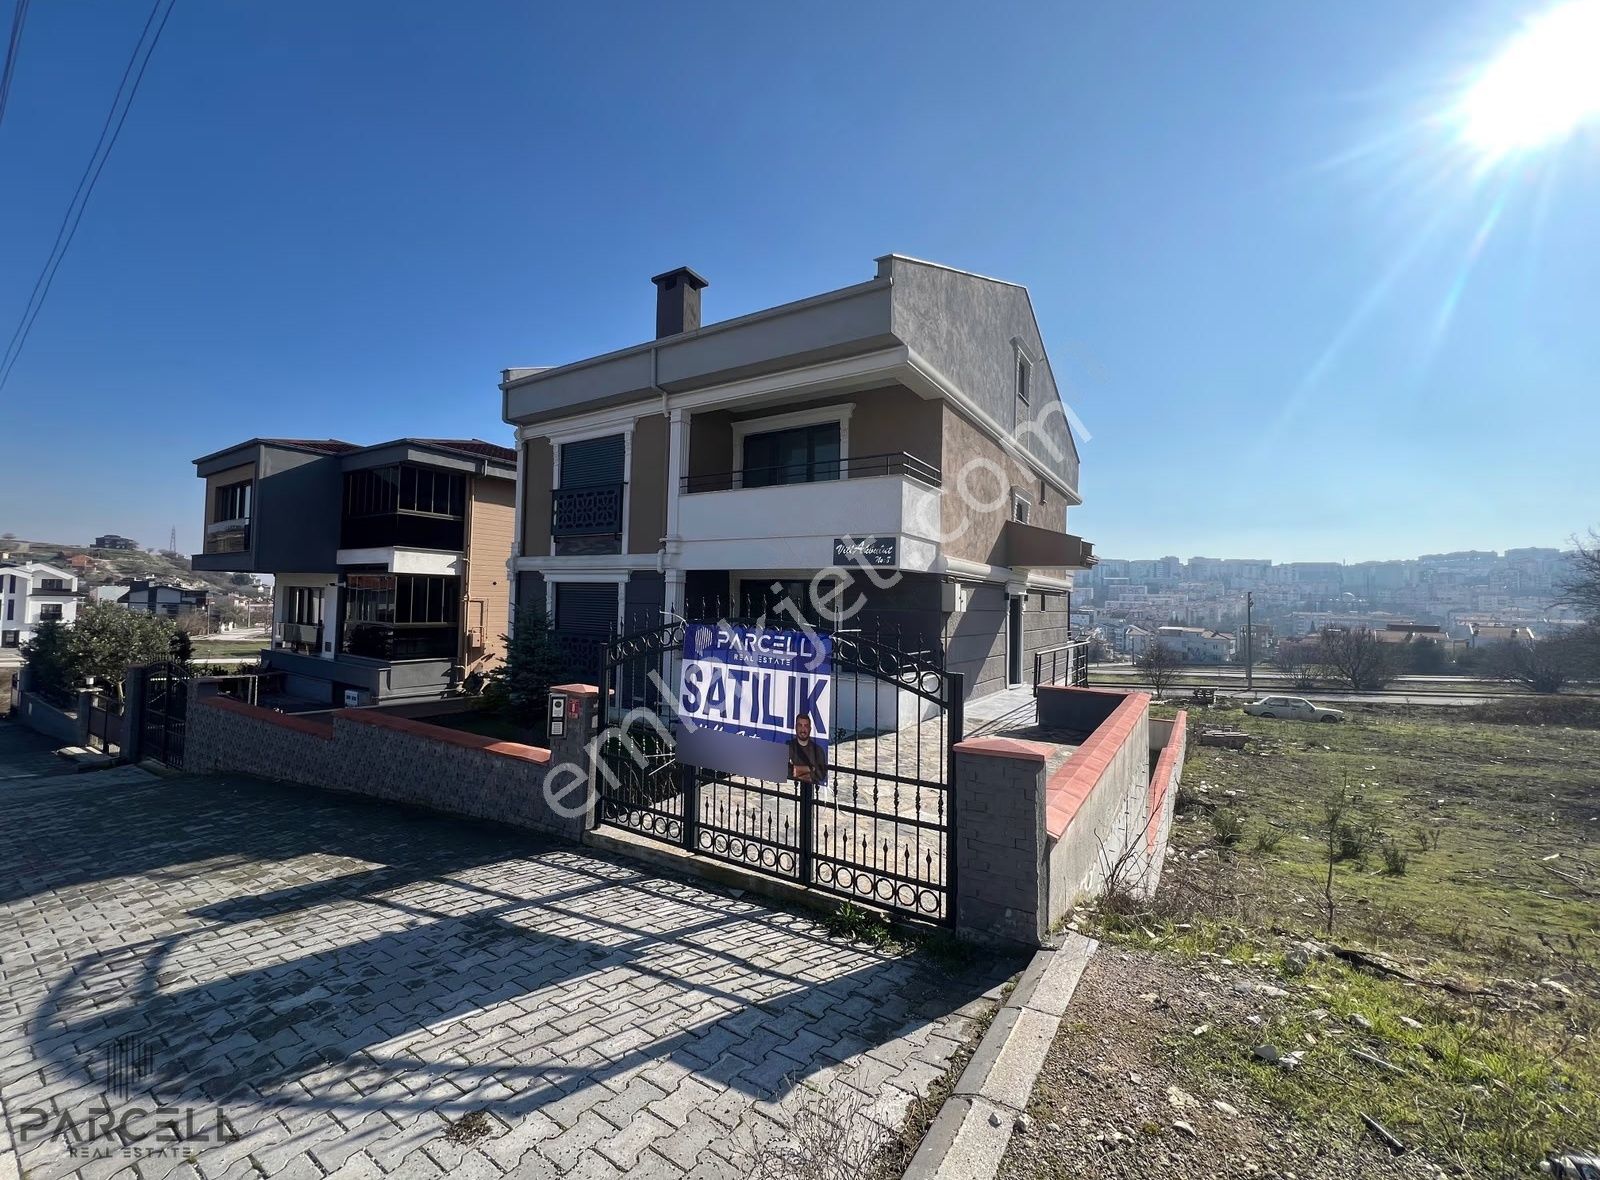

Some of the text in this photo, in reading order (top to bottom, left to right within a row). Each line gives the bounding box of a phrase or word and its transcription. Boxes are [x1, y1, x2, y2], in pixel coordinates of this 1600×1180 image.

[717, 630, 812, 657] PARCELL
[733, 654, 791, 666] REAL ESTATE
[683, 663, 829, 735] SATILIK
